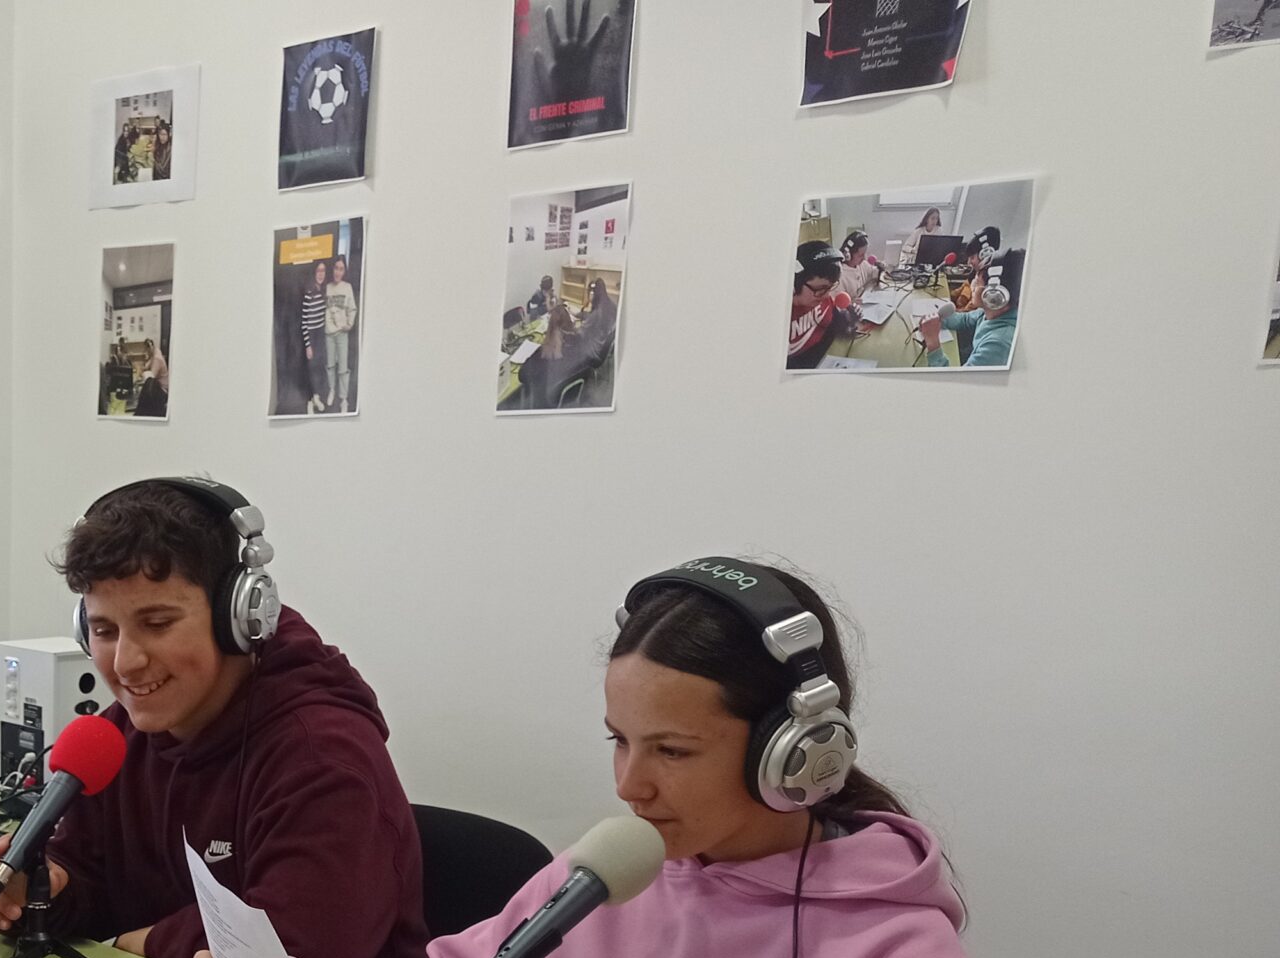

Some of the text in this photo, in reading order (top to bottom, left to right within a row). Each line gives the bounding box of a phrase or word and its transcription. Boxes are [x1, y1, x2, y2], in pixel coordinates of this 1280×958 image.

[335, 40, 353, 57] DEL
[529, 96, 606, 121] EL FRENTE CRIMINAL
[790, 304, 822, 341] NIKE
[209, 840, 232, 854] NIKE
